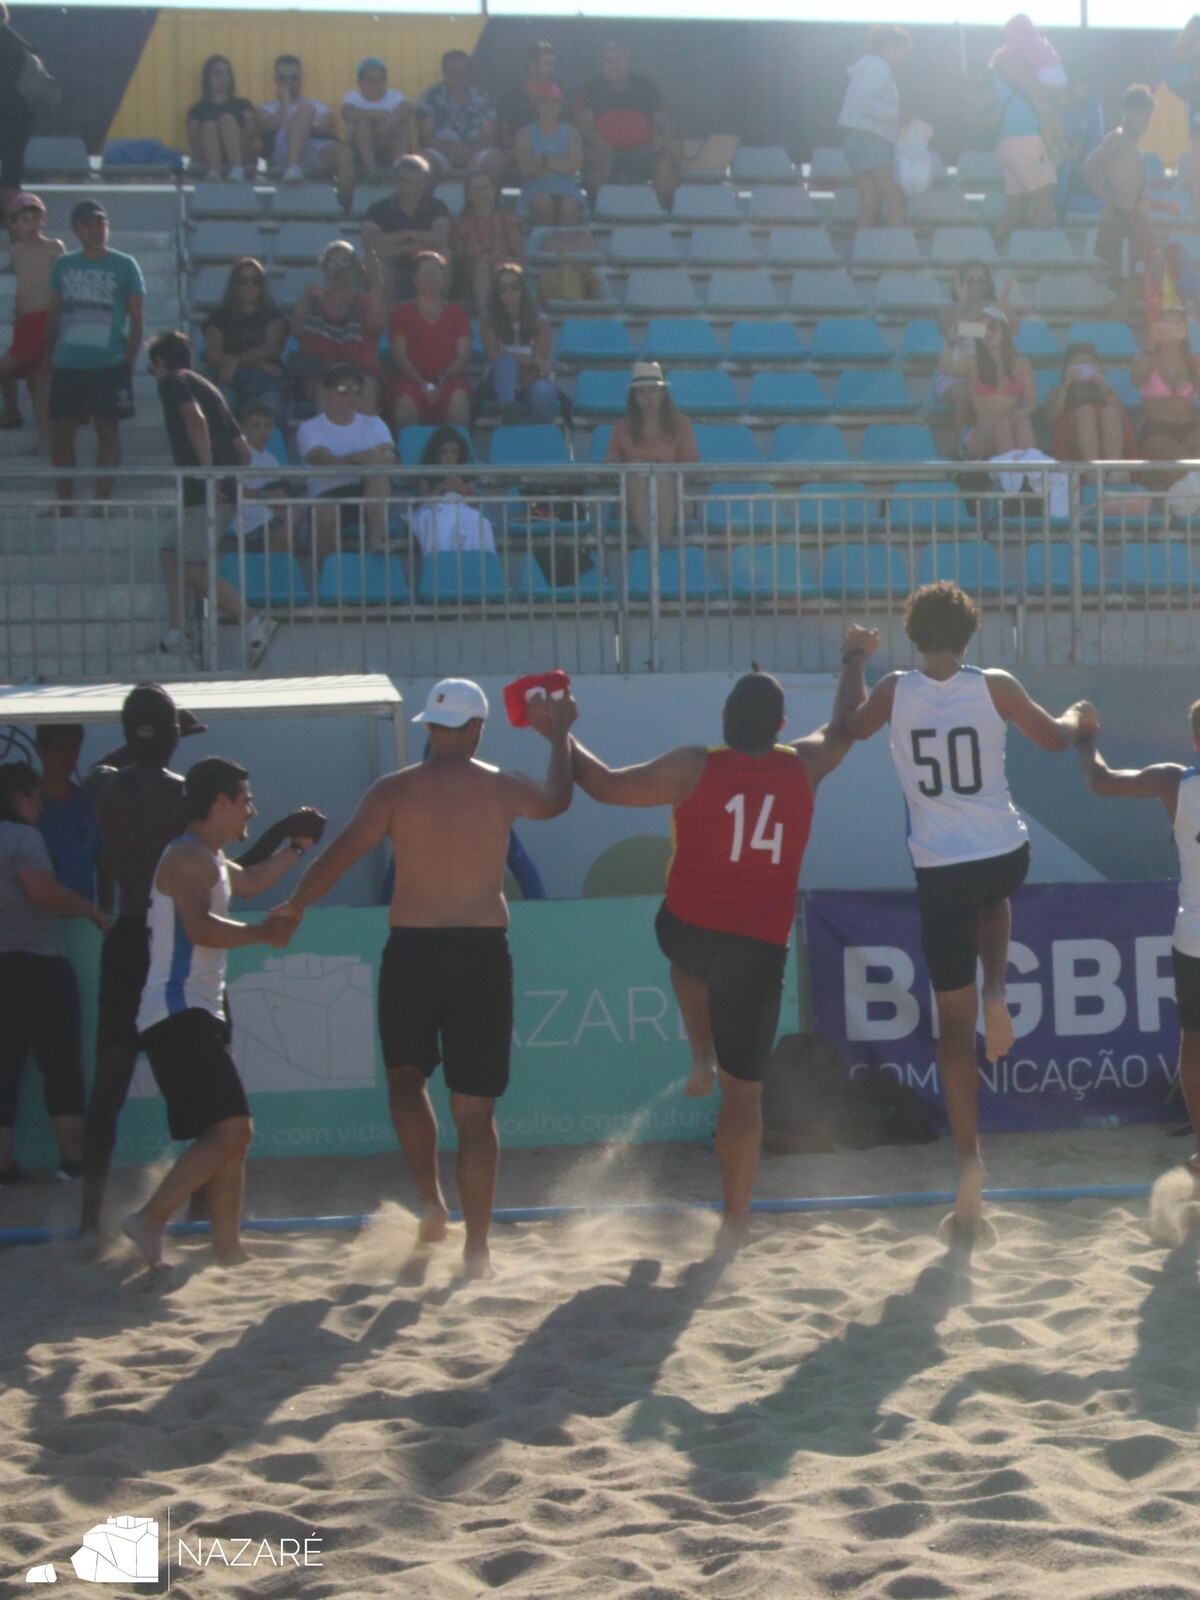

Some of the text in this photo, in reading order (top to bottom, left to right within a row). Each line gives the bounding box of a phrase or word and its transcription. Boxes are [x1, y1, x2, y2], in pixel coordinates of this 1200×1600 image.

[910, 727, 982, 797] 50
[724, 793, 784, 864] 14
[500, 1112, 573, 1136] celho
